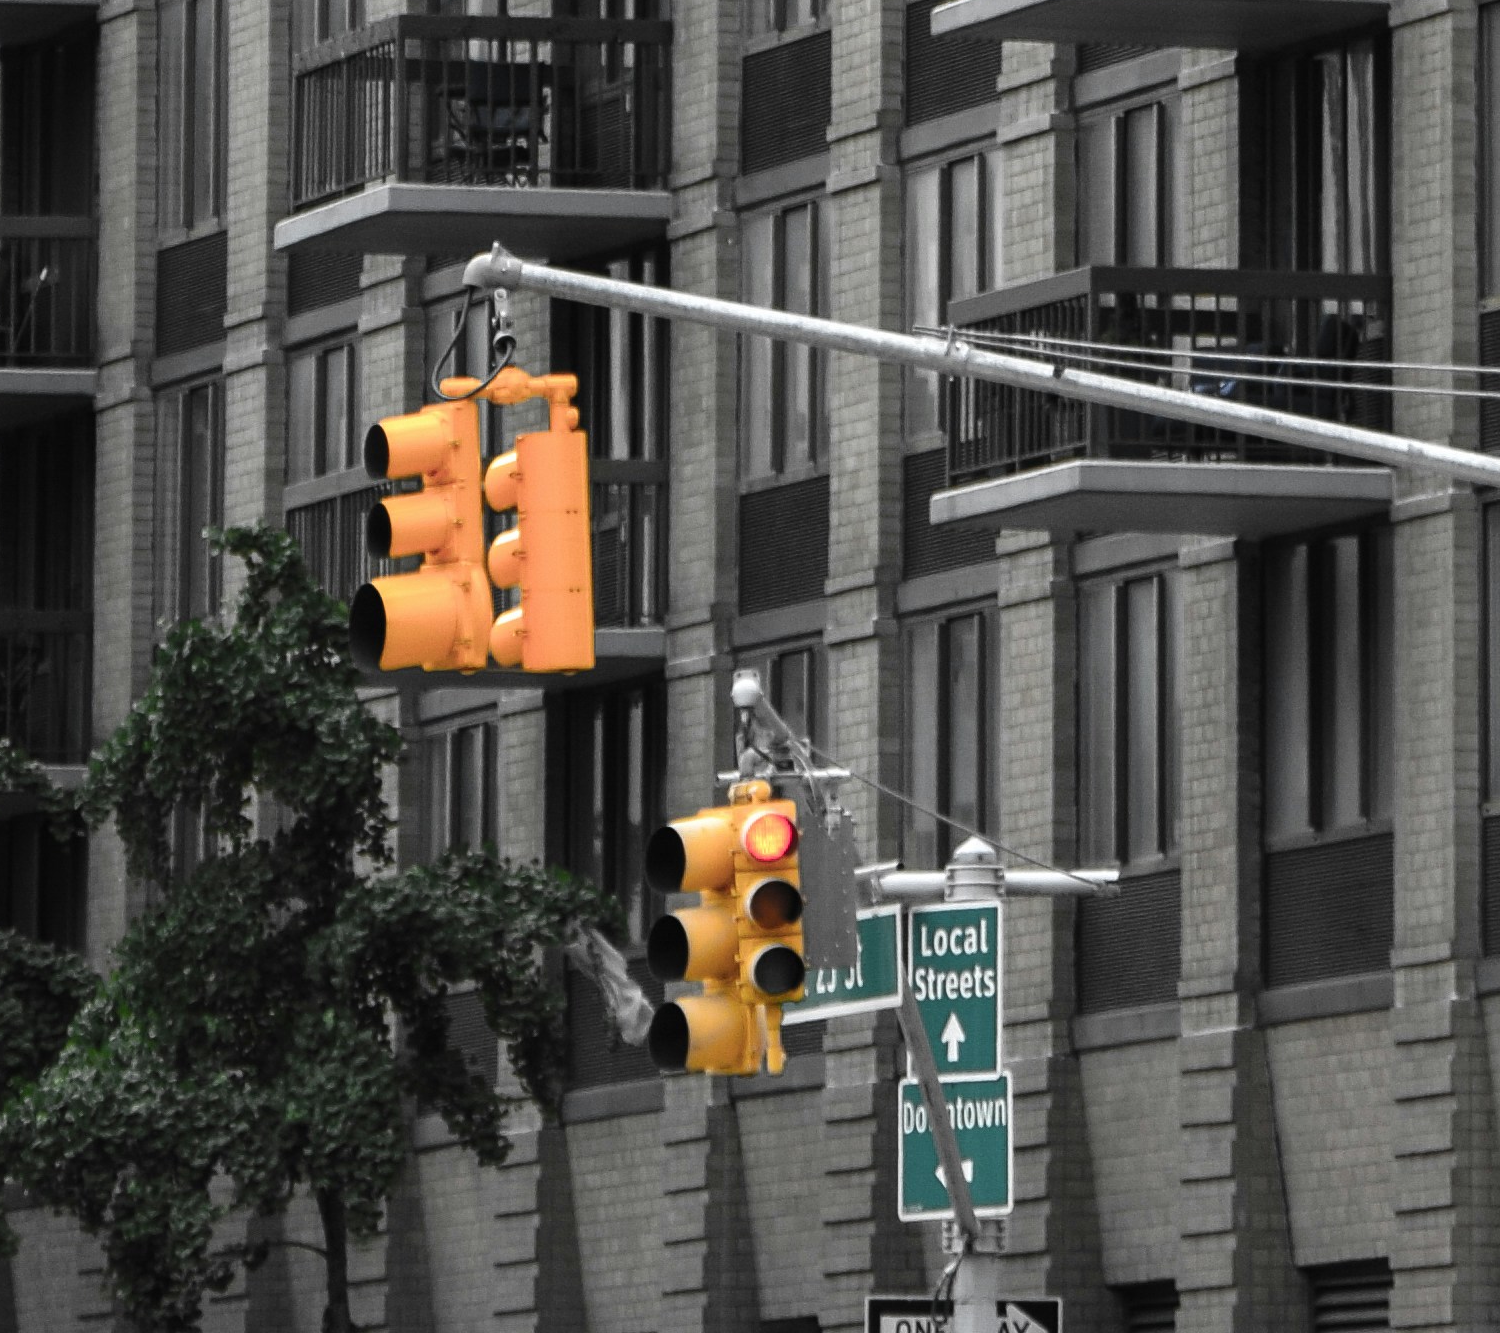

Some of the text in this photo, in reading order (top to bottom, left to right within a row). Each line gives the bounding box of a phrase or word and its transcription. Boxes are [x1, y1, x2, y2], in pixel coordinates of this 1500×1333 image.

[920, 918, 988, 957] Local
[914, 965, 996, 1001] Streets
[904, 1096, 1006, 1134] Dontown
